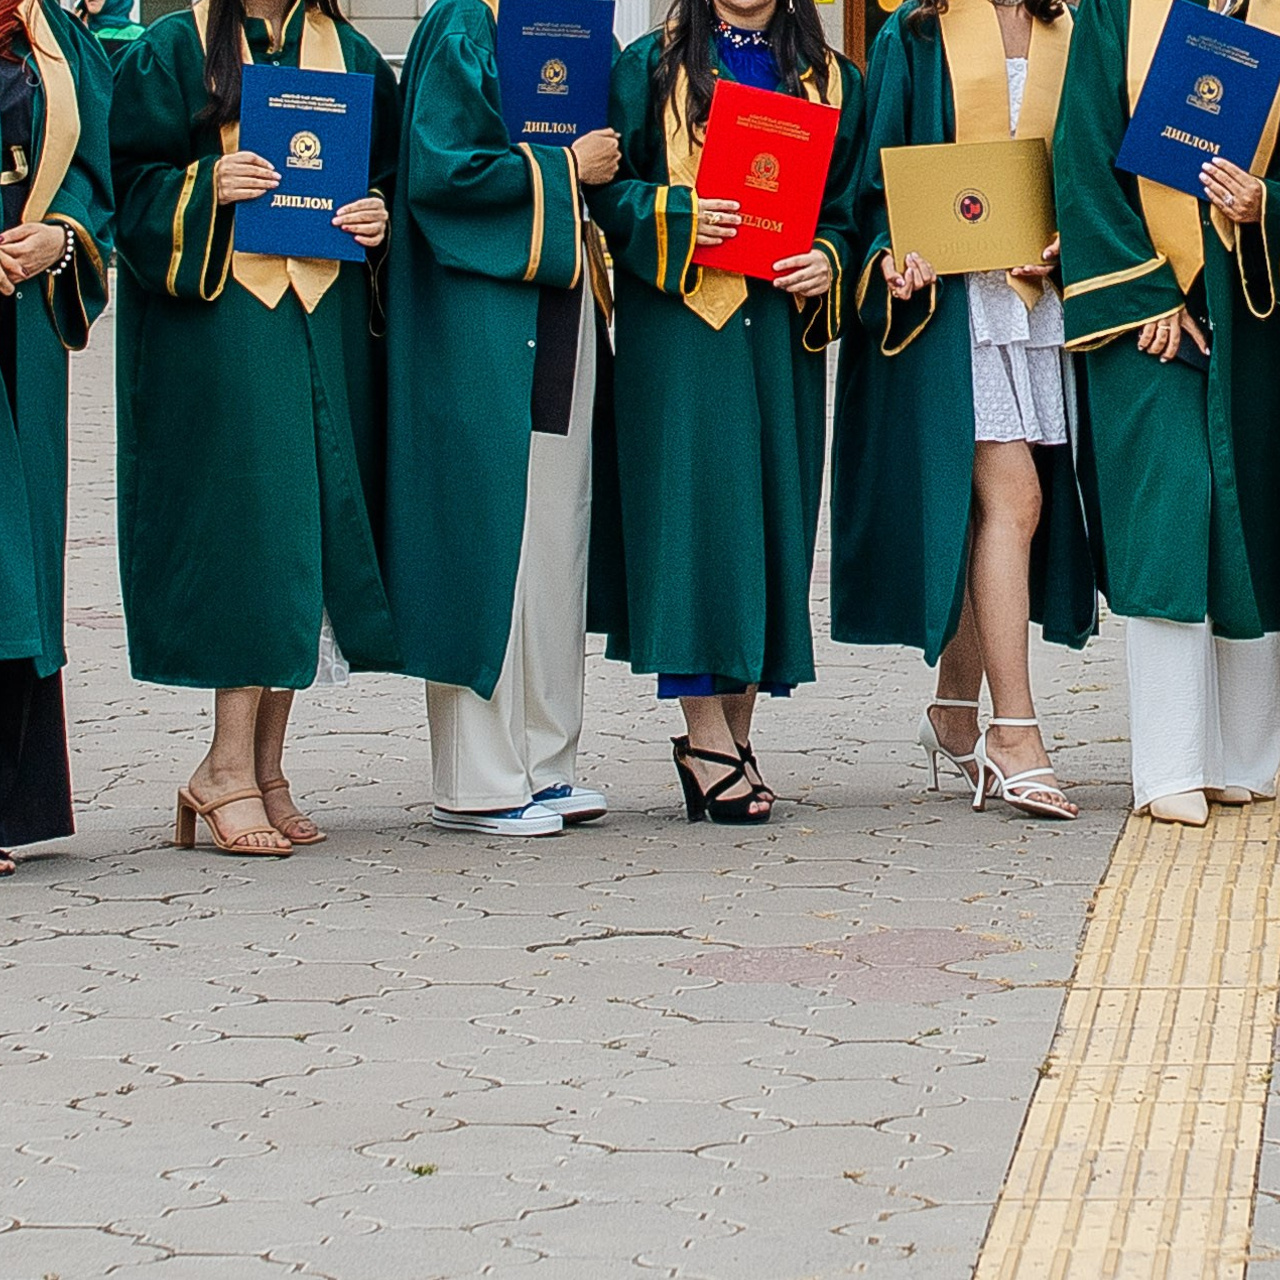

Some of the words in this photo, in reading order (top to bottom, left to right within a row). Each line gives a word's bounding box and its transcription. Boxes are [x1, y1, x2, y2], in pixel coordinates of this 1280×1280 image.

[522, 121, 577, 135] ДИПЛОМ
[1161, 125, 1221, 155] ДИПЛОМ
[271, 194, 333, 211] ДИПЛОМ
